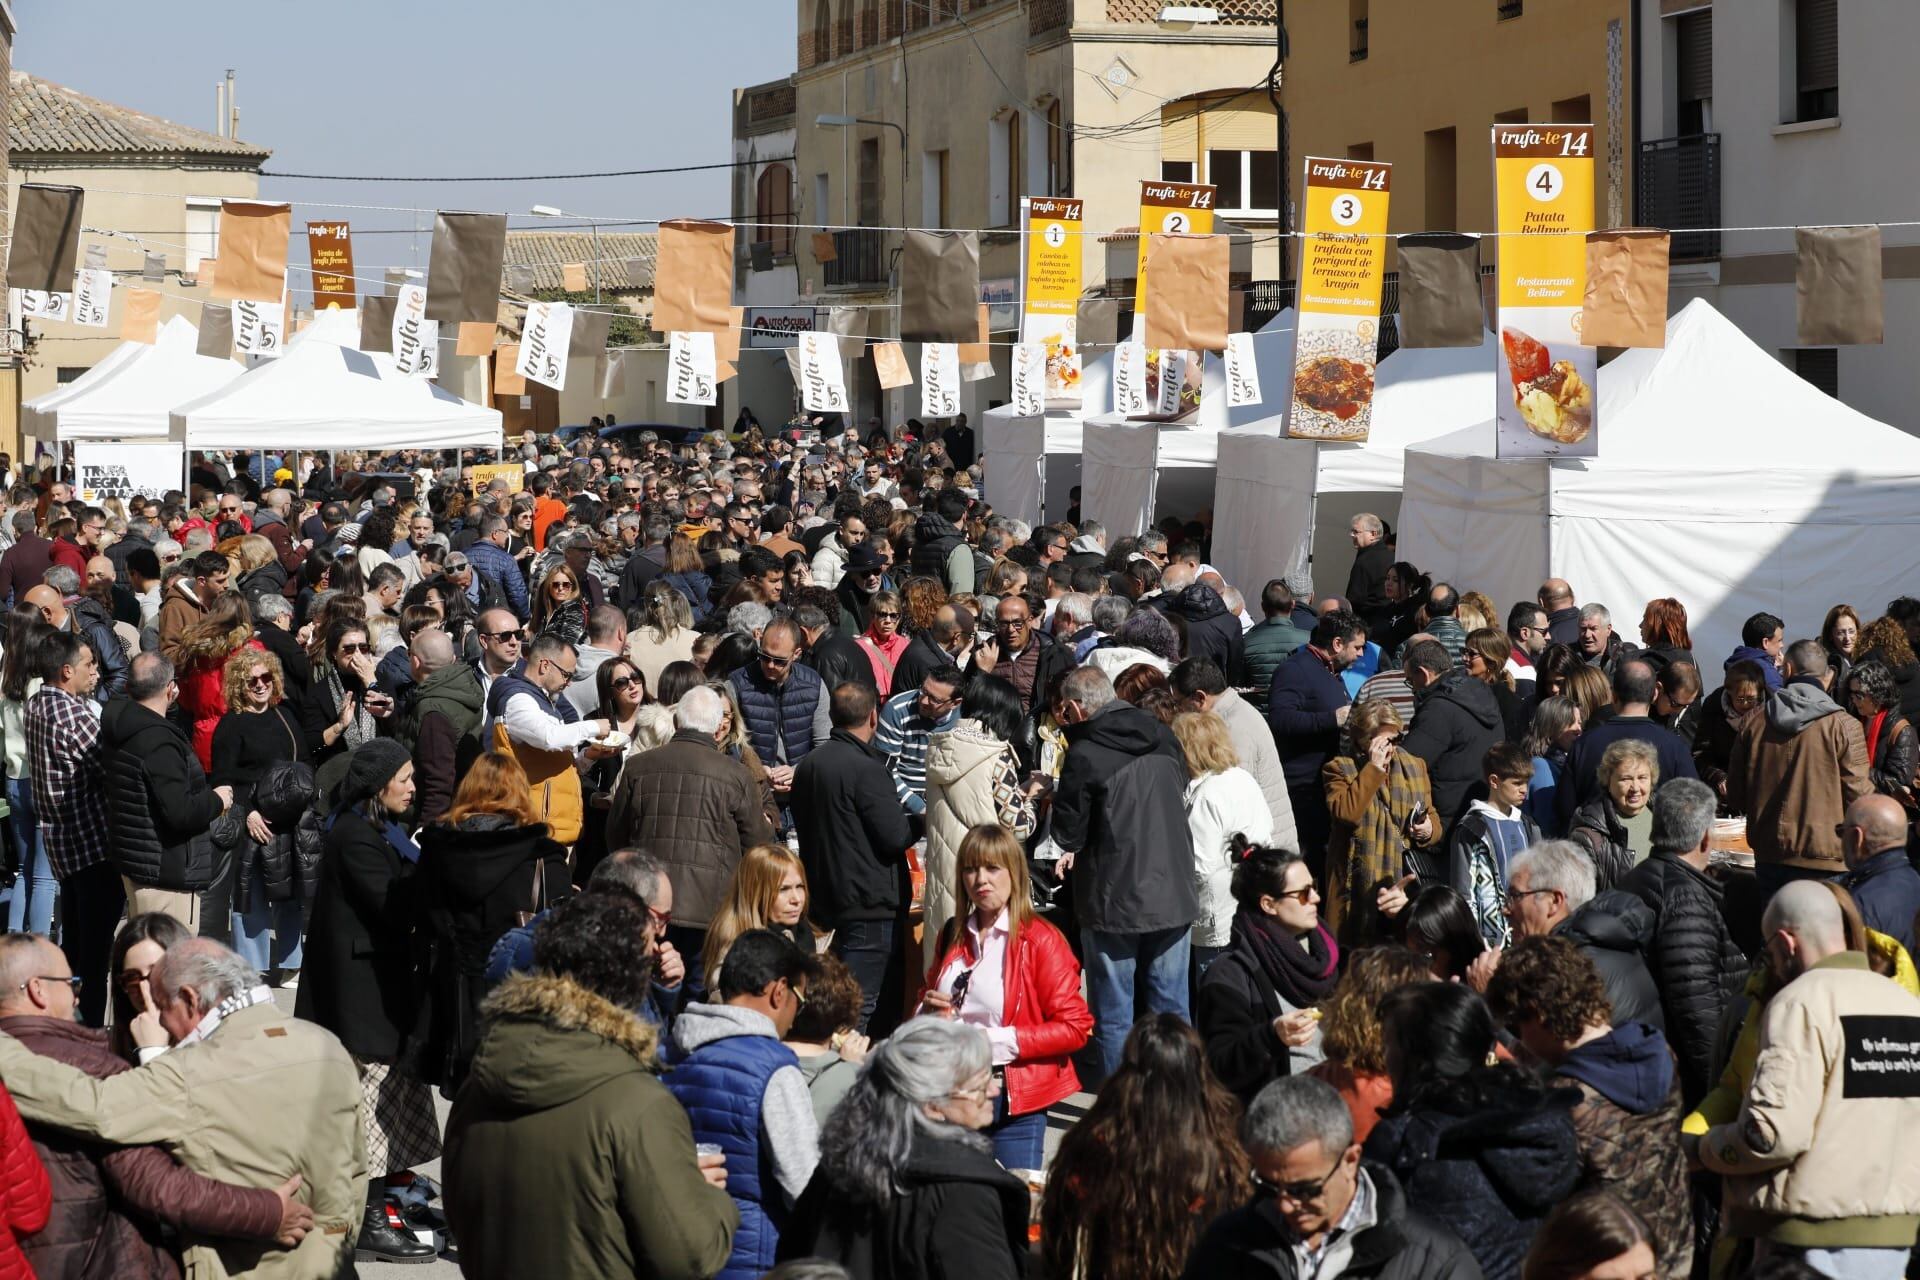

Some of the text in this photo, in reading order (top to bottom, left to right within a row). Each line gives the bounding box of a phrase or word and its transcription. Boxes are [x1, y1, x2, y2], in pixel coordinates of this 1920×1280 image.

[1501, 129, 1588, 156] trufa-te 14
[1313, 163, 1386, 190] trufa-te 14
[1535, 171, 1553, 194] 4
[1146, 186, 1211, 209] trufa-te 14
[1032, 201, 1080, 220] trufa-te 14
[1340, 200, 1353, 219] 3
[1525, 211, 1565, 223] Patata
[309, 225, 348, 240] trufa-te 14
[1170, 216, 1182, 233] 2
[1052, 228, 1059, 242] 1
[1314, 244, 1373, 257] trufada con
[1313, 255, 1372, 268] perigord de
[1312, 266, 1371, 279] ternasco de
[1322, 278, 1360, 291] Aragón
[1516, 277, 1575, 286] Restaurante
[1527, 287, 1565, 298] Bellmor
[397, 291, 425, 375] trufa-te
[807, 336, 824, 410] trufa-te
[925, 343, 941, 416] trufa-te
[83, 477, 132, 488] NEGRA
